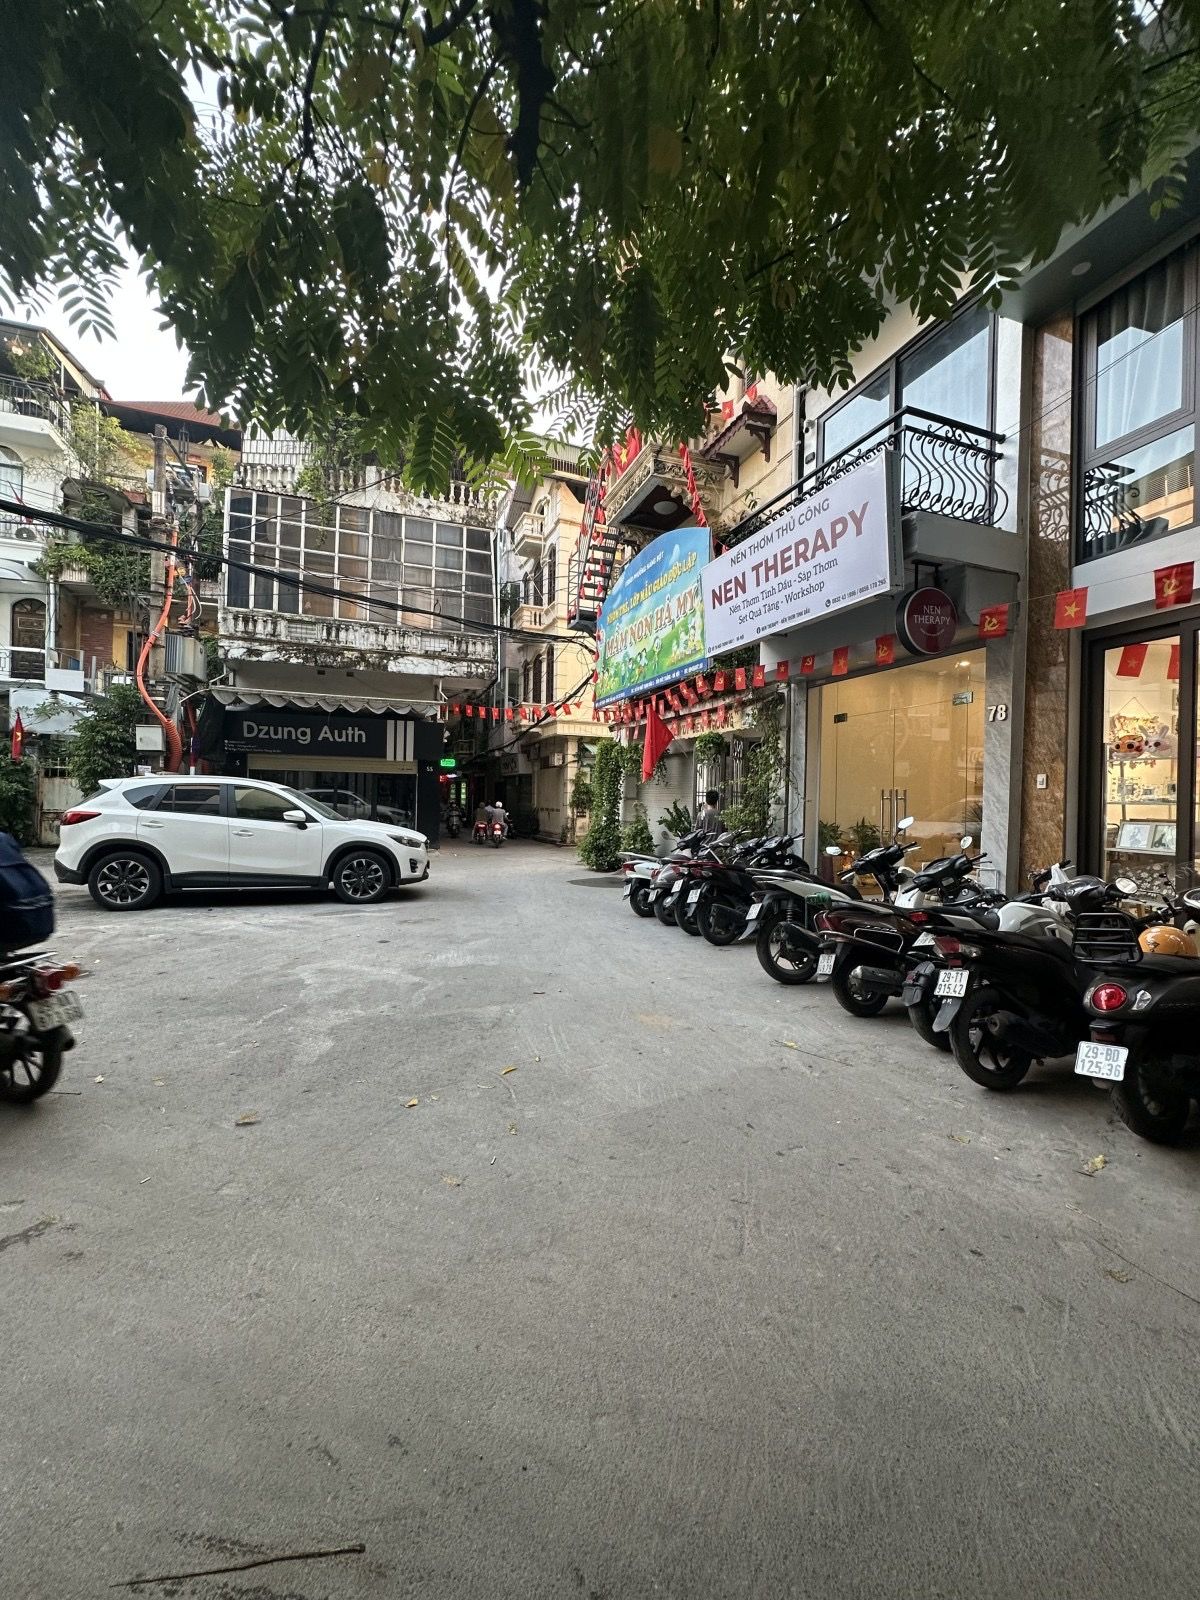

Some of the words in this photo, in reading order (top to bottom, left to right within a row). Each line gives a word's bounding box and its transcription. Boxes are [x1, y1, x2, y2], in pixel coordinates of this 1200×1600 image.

[748, 532, 774, 556] THƠM
[775, 515, 796, 540] THỦ
[798, 498, 830, 526] CÔNG
[711, 571, 748, 609] NEN
[751, 501, 869, 588] THERAPY
[813, 558, 838, 575] Thơm
[738, 614, 748, 624] Set
[785, 581, 825, 604] Workshop
[923, 604, 941, 614] NEN
[629, 612, 653, 642] NON
[913, 614, 951, 625] THERAPY
[987, 704, 1007, 722] 78
[242, 720, 311, 744] Dzung
[317, 725, 366, 743] Auth
[942, 972, 963, 983] 29-T1
[936, 983, 963, 995] 915.42
[1084, 1045, 1120, 1062] 29-BD
[1080, 1059, 1122, 1077] 125.36
